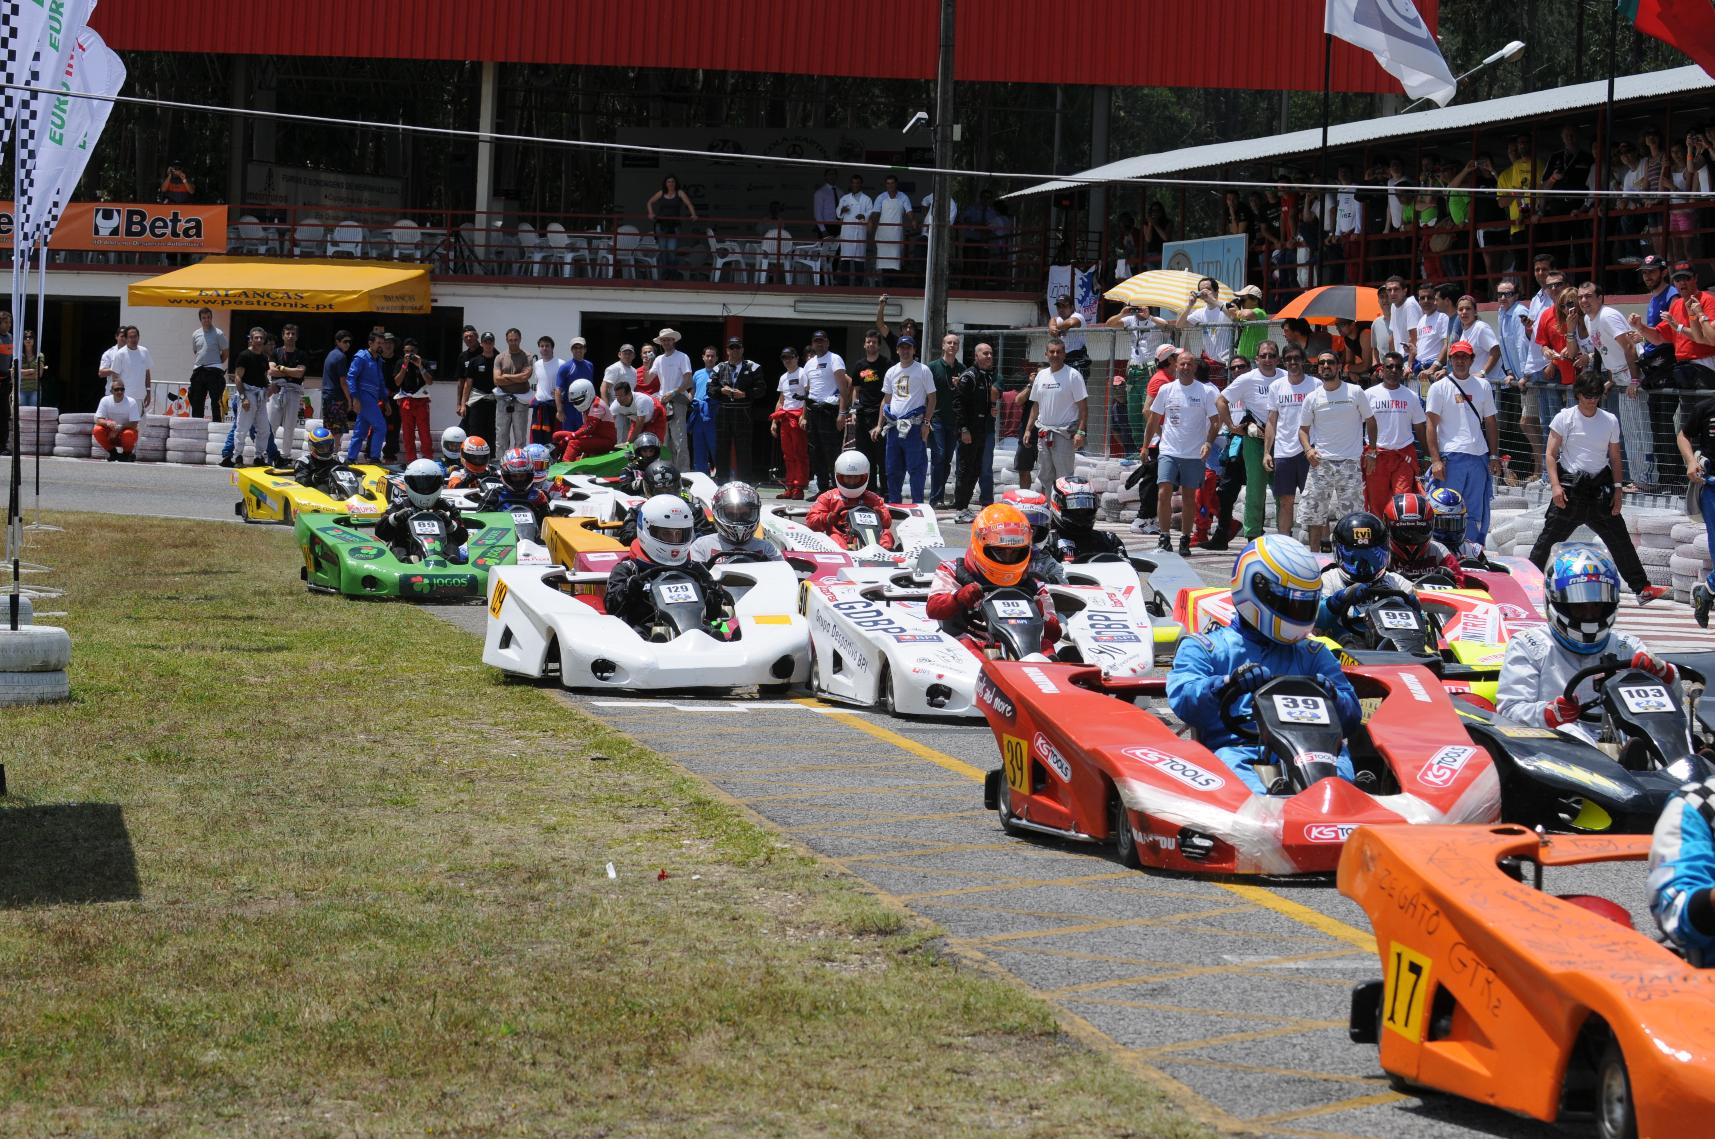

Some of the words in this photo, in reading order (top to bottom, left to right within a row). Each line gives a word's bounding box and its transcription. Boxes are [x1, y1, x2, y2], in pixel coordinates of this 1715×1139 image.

[48, 0, 65, 53] EUR
[124, 208, 204, 239] Beta
[168, 298, 336, 312] www.pestronix.pt
[1375, 399, 1409, 410] UNITRIP
[417, 521, 436, 529] 89
[1354, 529, 1372, 539] tvi
[432, 577, 468, 588] JOGOS
[665, 584, 689, 593] 129
[1385, 611, 1412, 620] 99
[816, 608, 830, 633] Grupo
[831, 624, 858, 661] Desportivo
[857, 653, 869, 674] BPI
[1623, 688, 1664, 699] 103
[993, 697, 1013, 717] more
[1281, 696, 1320, 709] 39
[1049, 748, 1070, 780] TOOLS
[1442, 745, 1470, 771] TOOLS
[1006, 741, 1024, 790] 39
[1128, 748, 1165, 763] KS
[1163, 756, 1217, 788] TOOLS
[1310, 826, 1339, 839] KS
[1387, 951, 1424, 1028] 17
